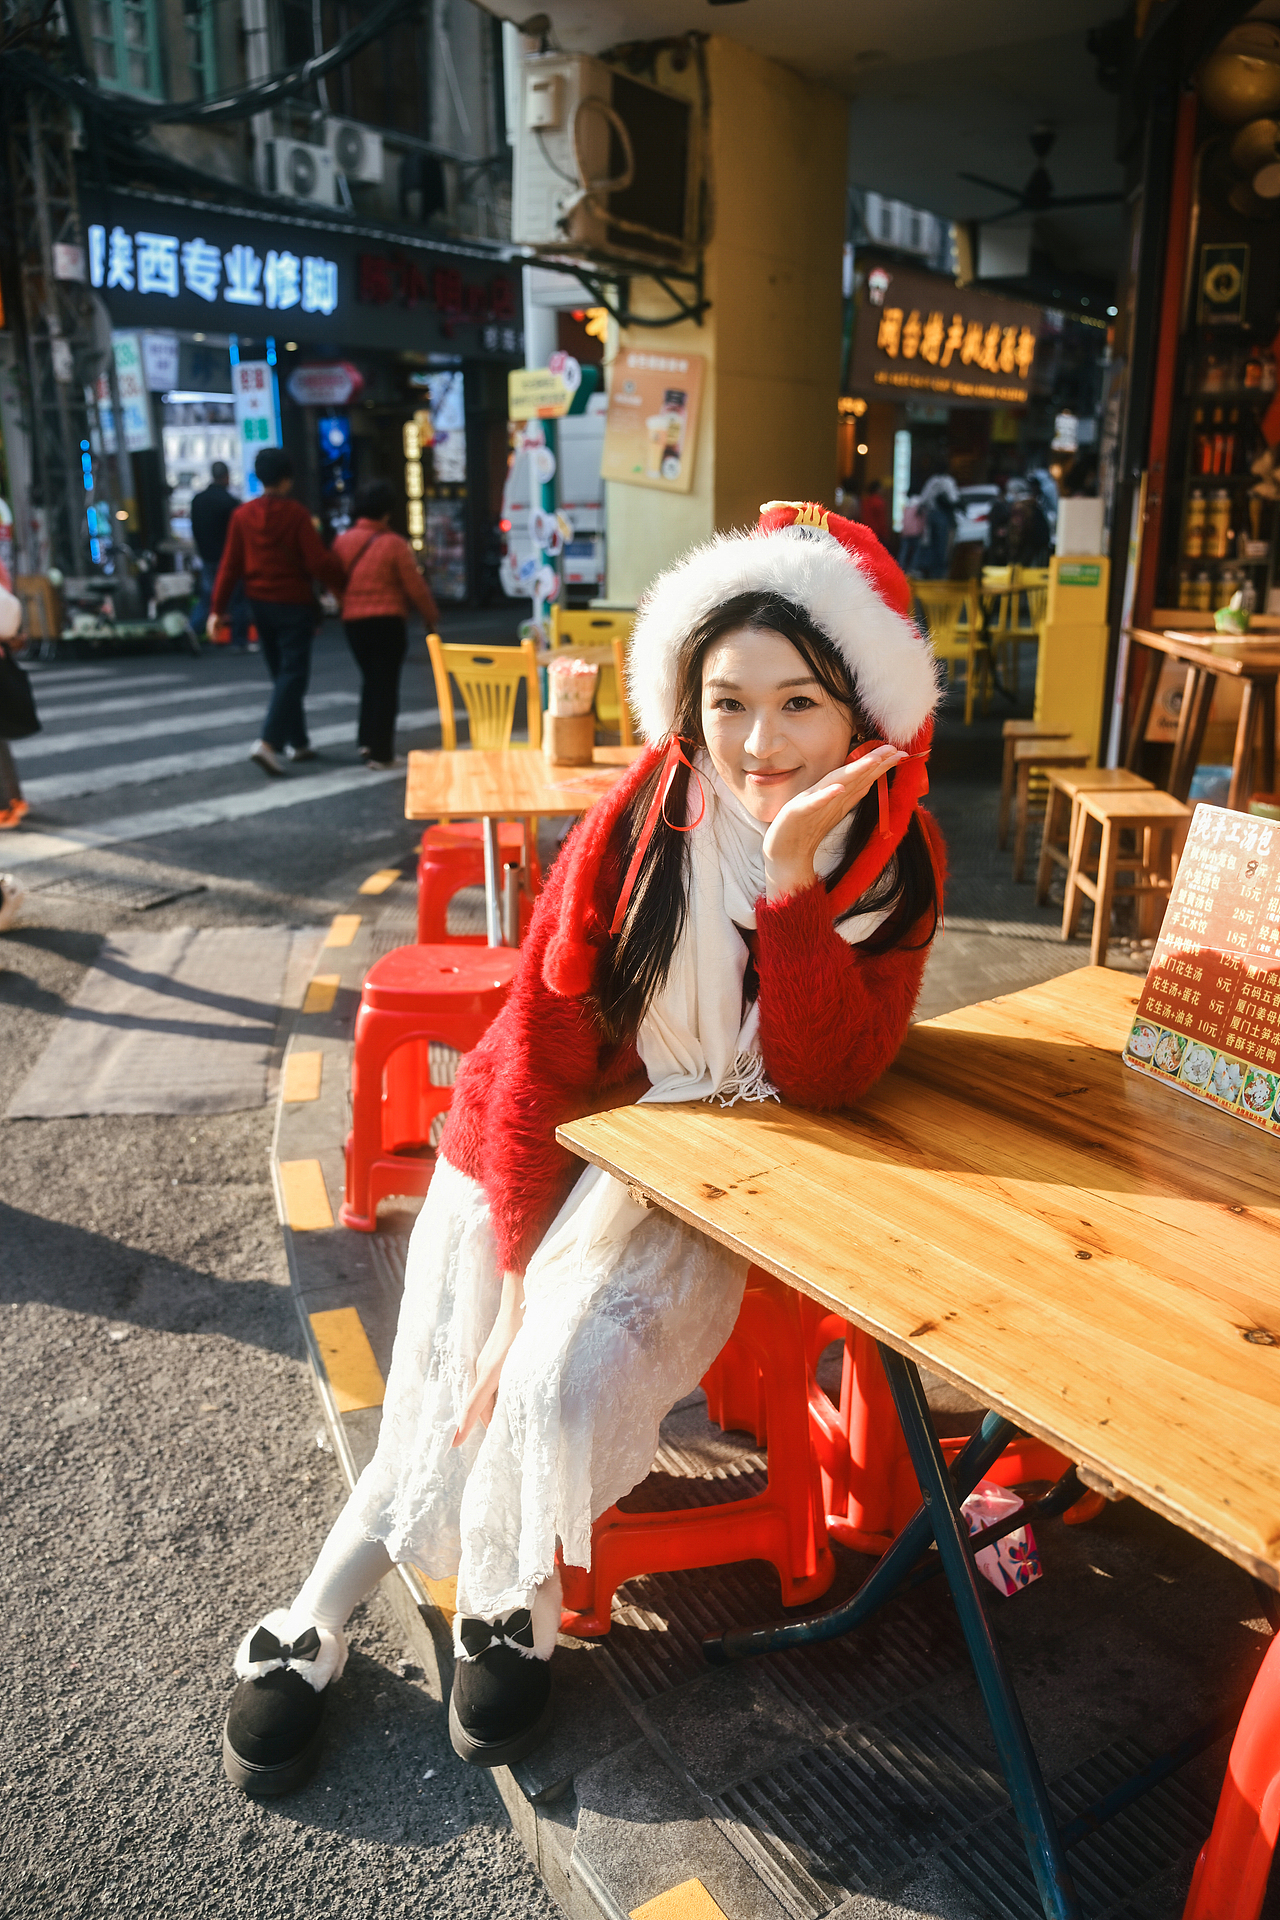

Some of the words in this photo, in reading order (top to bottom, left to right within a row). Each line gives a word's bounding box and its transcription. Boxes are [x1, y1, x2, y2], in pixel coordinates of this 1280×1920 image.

[88, 223, 339, 316] 陕西专业修脚
[1193, 810, 1273, 856] 纯手工汤包
[1184, 868, 1221, 890] 小笼汤包
[1240, 885, 1262, 902] 15元
[1177, 888, 1214, 912] 蟹黄汤包
[1232, 907, 1254, 925] 28元
[1171, 911, 1208, 935] 手工水饺
[1226, 930, 1248, 948] 18元
[1258, 925, 1280, 944] 经典
[1164, 932, 1201, 957] 鲜肉馄饨
[1219, 953, 1240, 971] 12元
[1158, 953, 1204, 982] 厦门花生汤
[1216, 976, 1232, 993] 8元
[1152, 975, 1202, 1006] 花生汤+蛋花
[1209, 999, 1225, 1015] 8元
[1235, 998, 1280, 1027] 厦门姜母
[1241, 982, 1280, 1008] 石码五香
[1145, 997, 1194, 1028] 花生汤+油条
[1197, 1019, 1218, 1038] 10元
[1229, 1015, 1280, 1046] 厦门土笋冻
[1225, 1032, 1277, 1064] 香酥芋泥鸭
